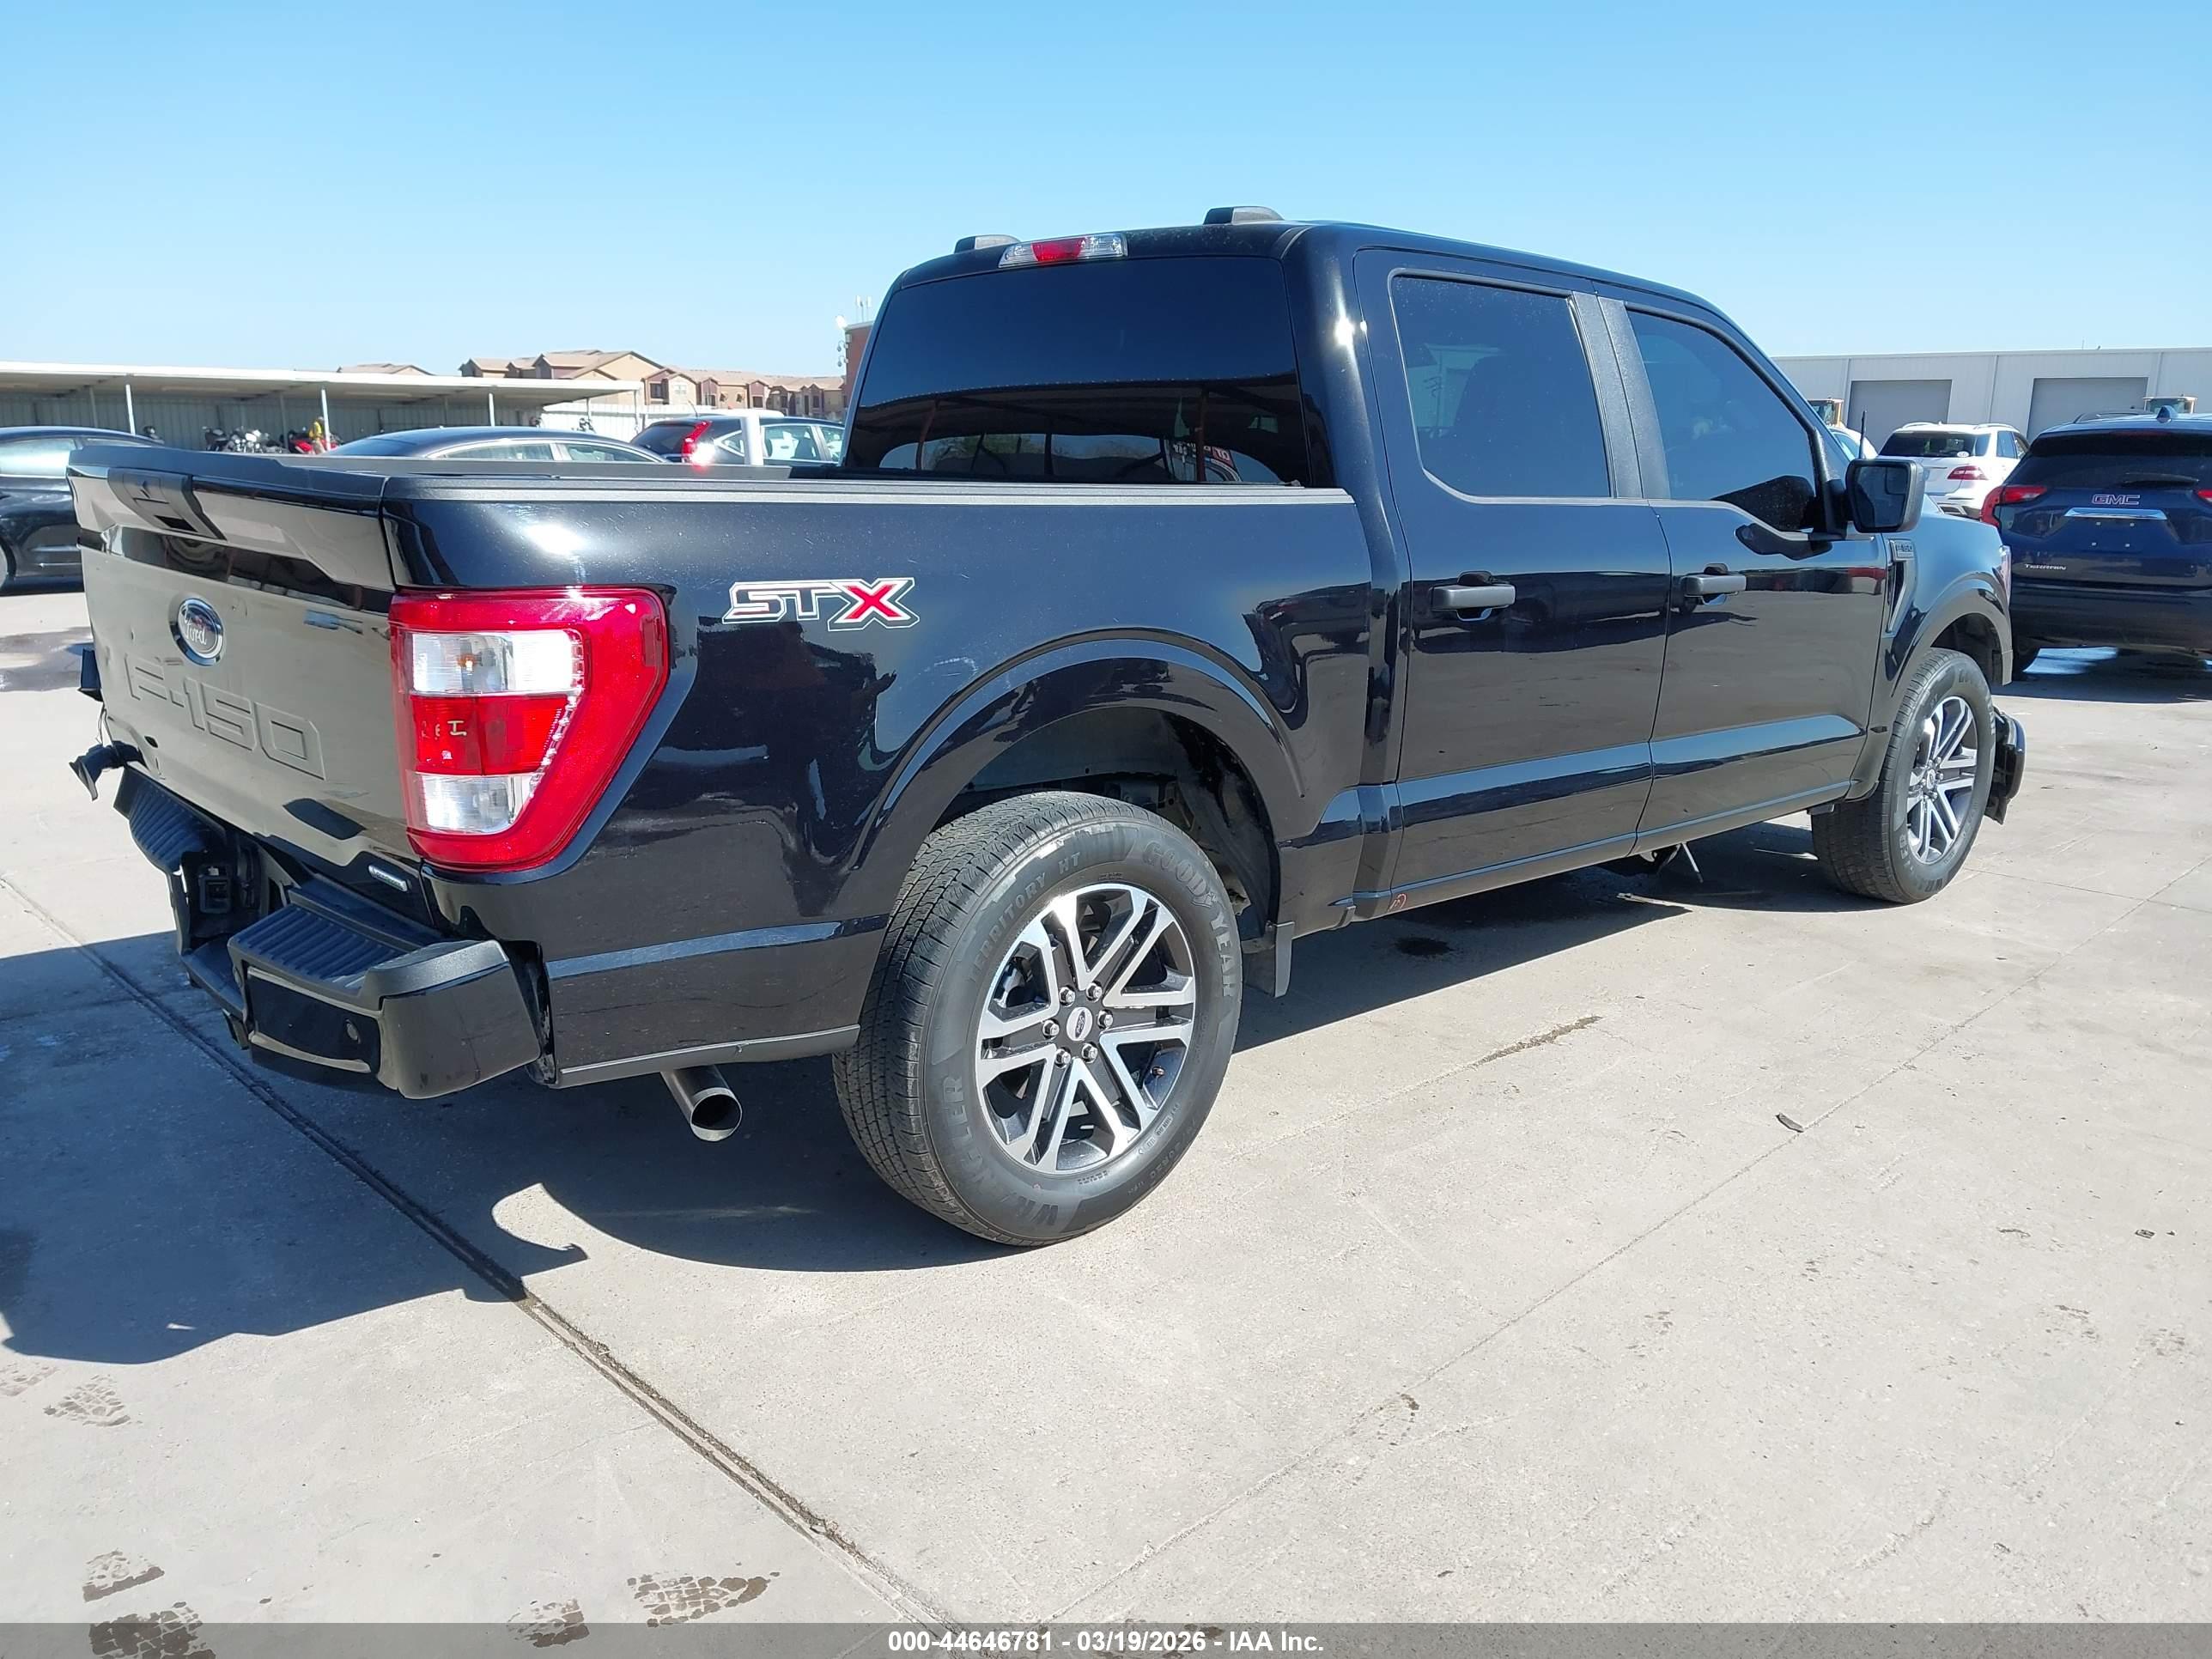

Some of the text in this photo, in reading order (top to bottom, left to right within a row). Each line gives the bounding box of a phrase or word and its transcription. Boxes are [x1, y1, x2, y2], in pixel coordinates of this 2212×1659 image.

[2091, 494, 2141, 505] GMC
[722, 577, 921, 631] STX
[124, 653, 326, 781] F-150
[1142, 839, 1235, 997] GOODYEAR
